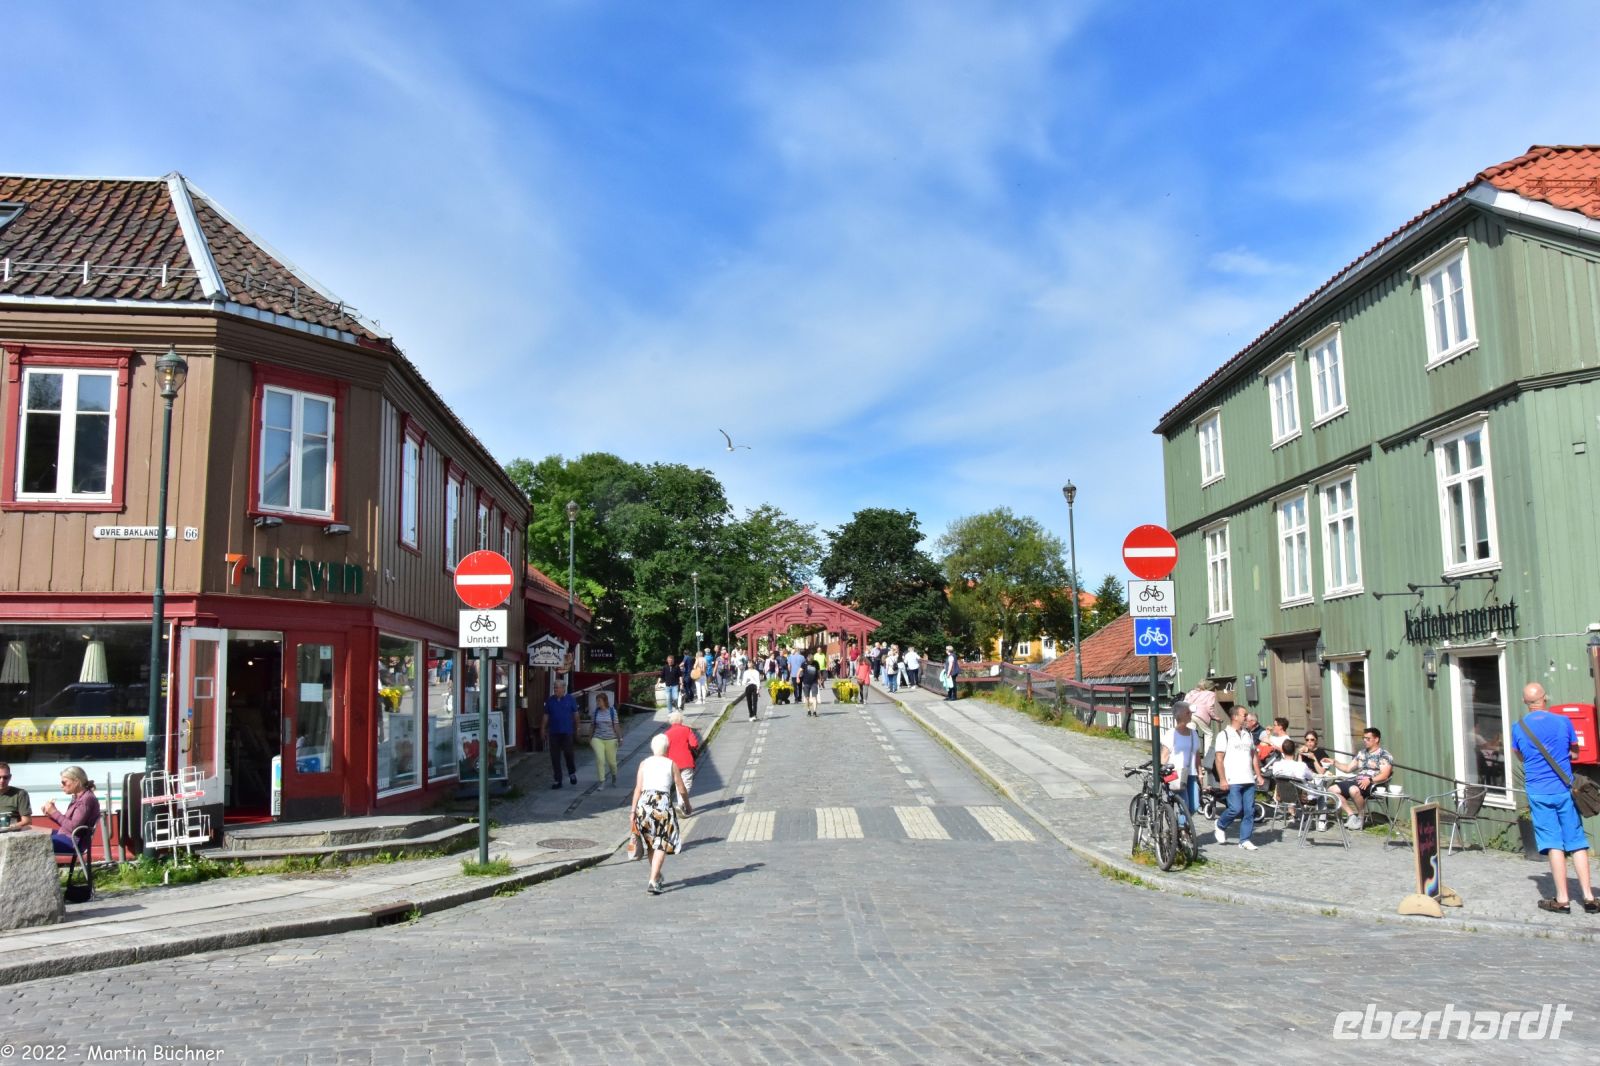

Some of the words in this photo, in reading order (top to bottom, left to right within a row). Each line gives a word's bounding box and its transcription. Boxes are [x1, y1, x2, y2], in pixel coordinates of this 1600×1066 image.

[124, 528, 169, 537] BAKLANDT
[185, 529, 198, 539] 66
[1136, 604, 1168, 613] Unntatt
[466, 635, 499, 644] Unntatt
